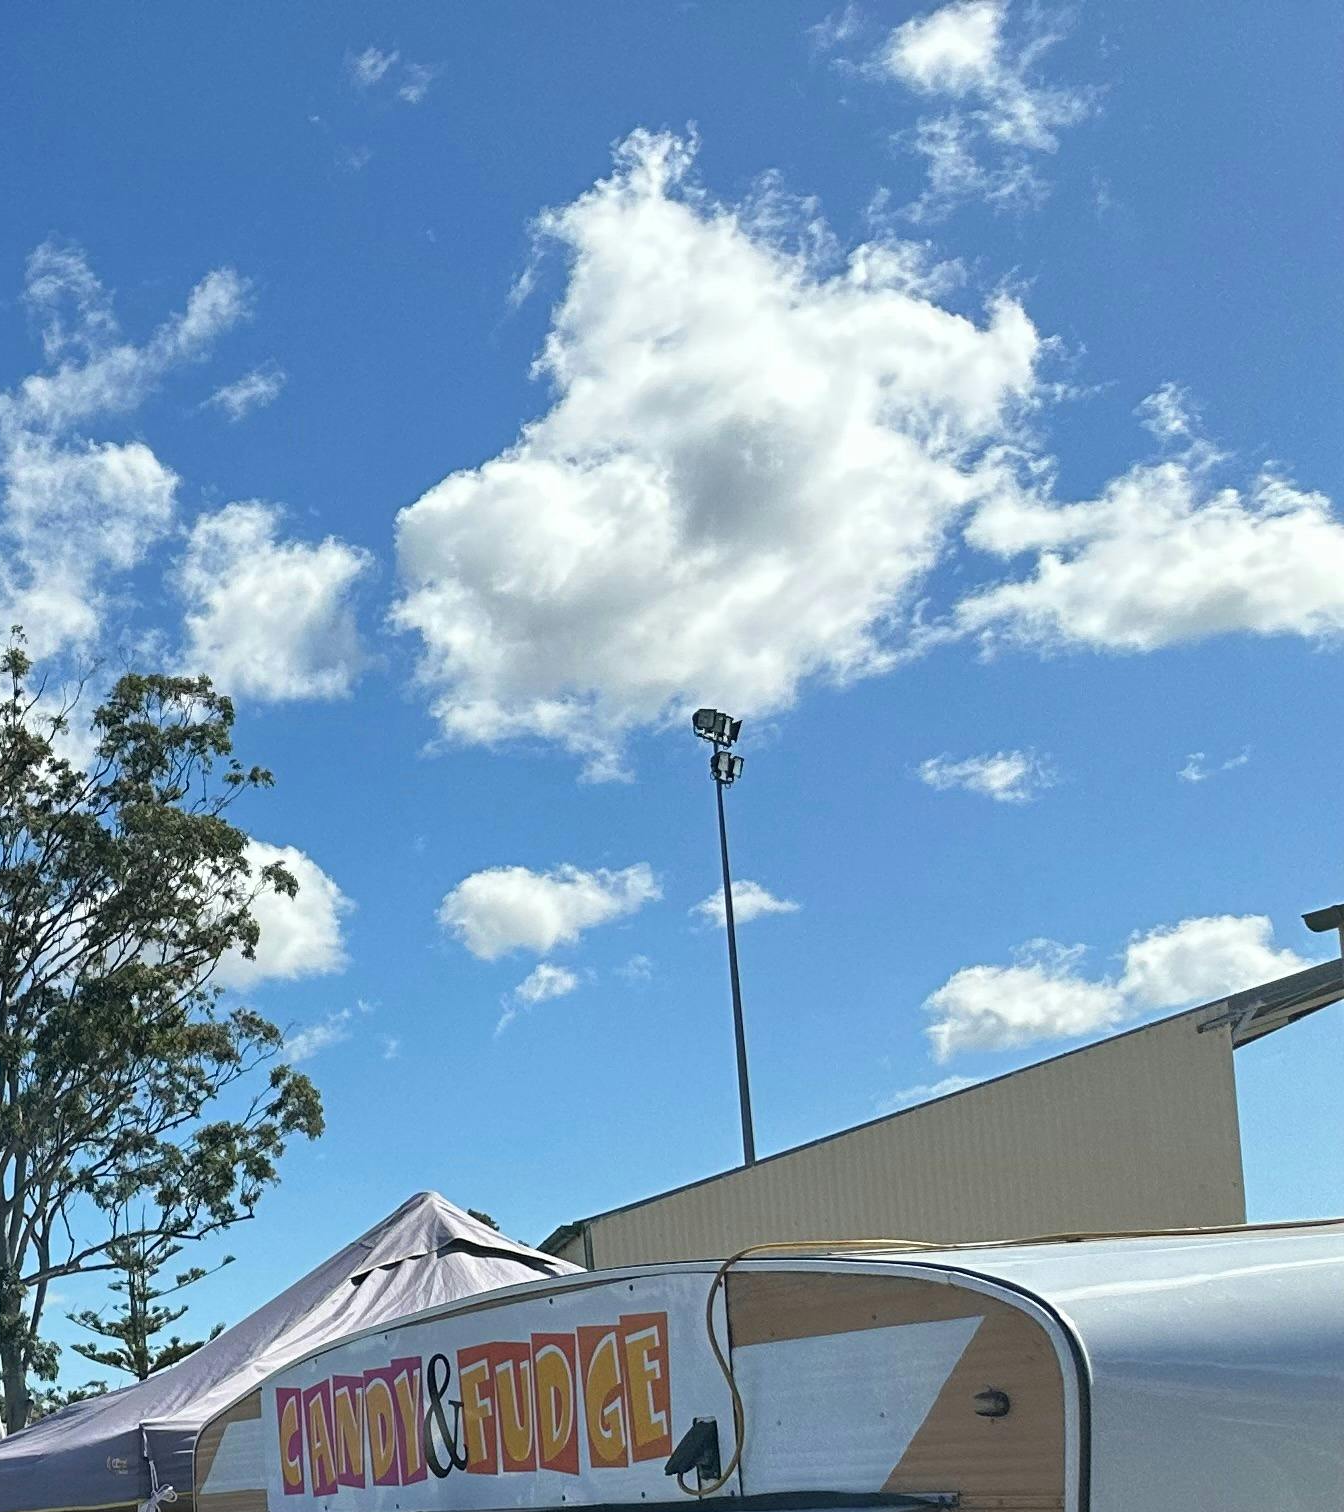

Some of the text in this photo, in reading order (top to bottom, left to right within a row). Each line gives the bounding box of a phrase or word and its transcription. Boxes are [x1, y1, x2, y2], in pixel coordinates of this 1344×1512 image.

[278, 1324, 669, 1490] CANDY & FUDGE
